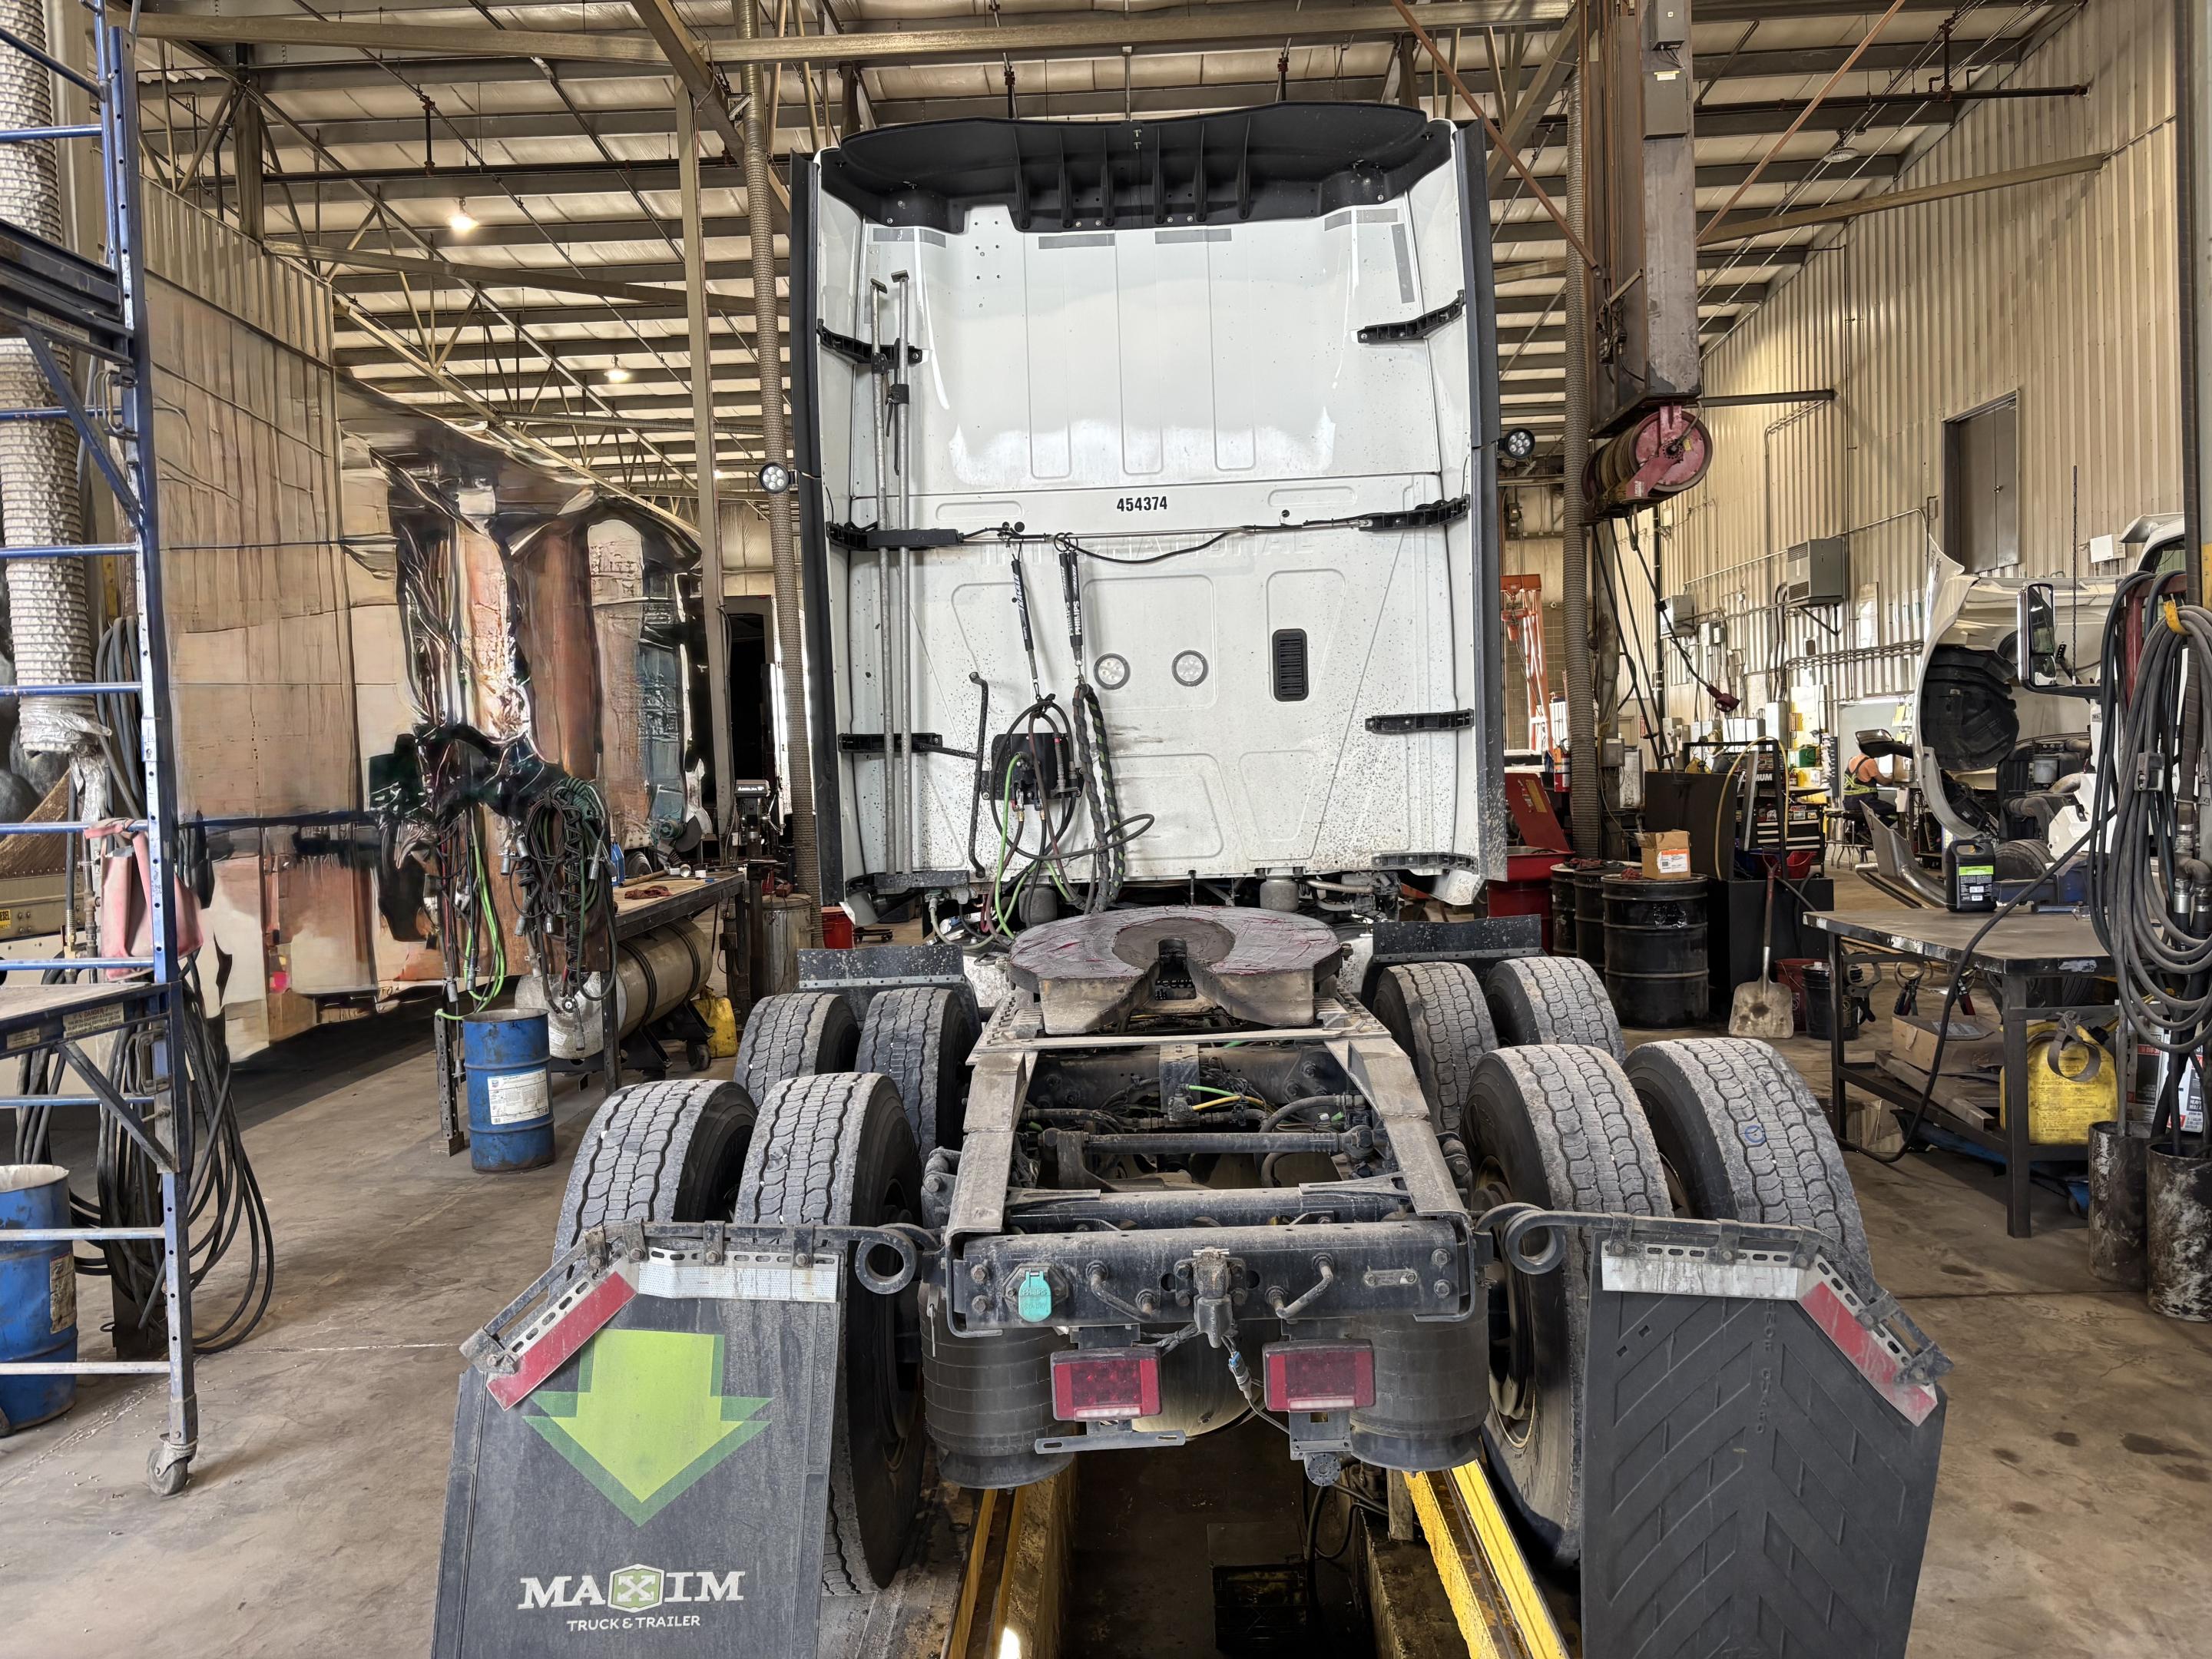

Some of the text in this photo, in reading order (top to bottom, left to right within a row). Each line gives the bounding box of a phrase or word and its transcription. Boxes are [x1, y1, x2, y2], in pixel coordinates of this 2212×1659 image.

[1116, 495, 1168, 512] 454374
[1013, 573, 1025, 611] TRACKER
[1073, 601, 1081, 635] PHILLIPS
[517, 1571, 746, 1610] MAXIM
[567, 1615, 700, 1632] TRUCK & TRAILER
